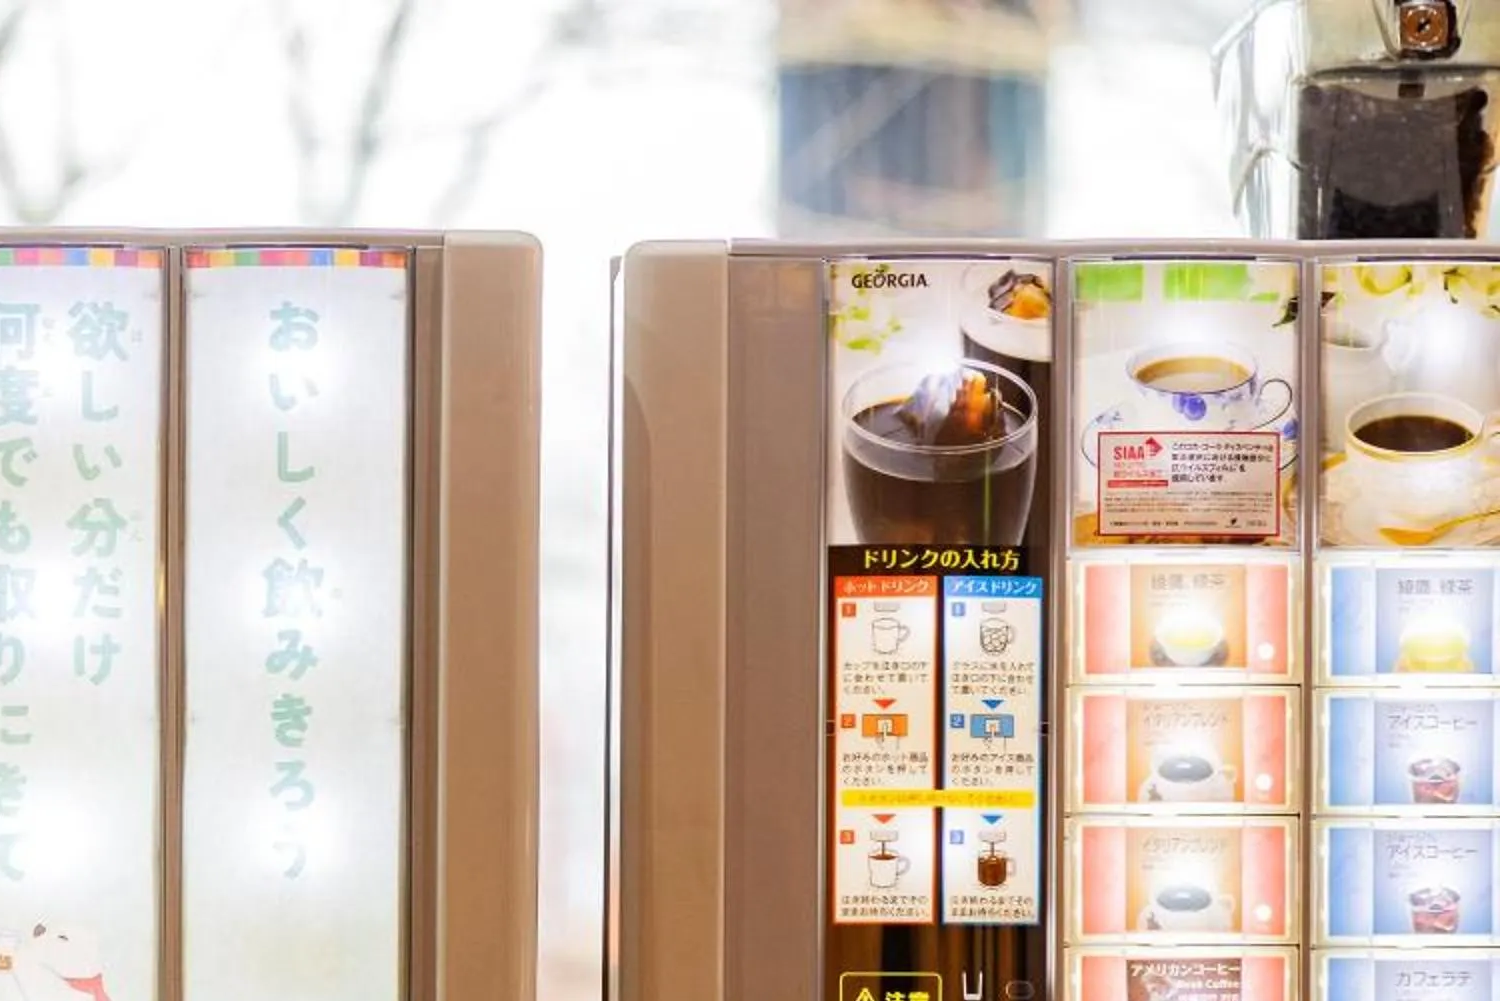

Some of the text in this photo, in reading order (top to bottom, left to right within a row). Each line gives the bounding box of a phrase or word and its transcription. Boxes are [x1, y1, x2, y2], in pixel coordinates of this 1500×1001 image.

[851, 272, 928, 289] GEORGIA
[66, 300, 131, 686] 欲しい分だけ
[863, 549, 1021, 571] ドリンクの入れ方
[261, 300, 325, 880] おいしく飲みきろう
[843, 579, 930, 594] ホットドリンク
[951, 580, 1038, 595] アイスドリンク
[1387, 714, 1478, 731] アイスコーヒー
[1386, 843, 1479, 860] アイスコーヒー
[1129, 963, 1241, 977] アメリカンコーヒー
[1394, 971, 1473, 987] カフェラテ
